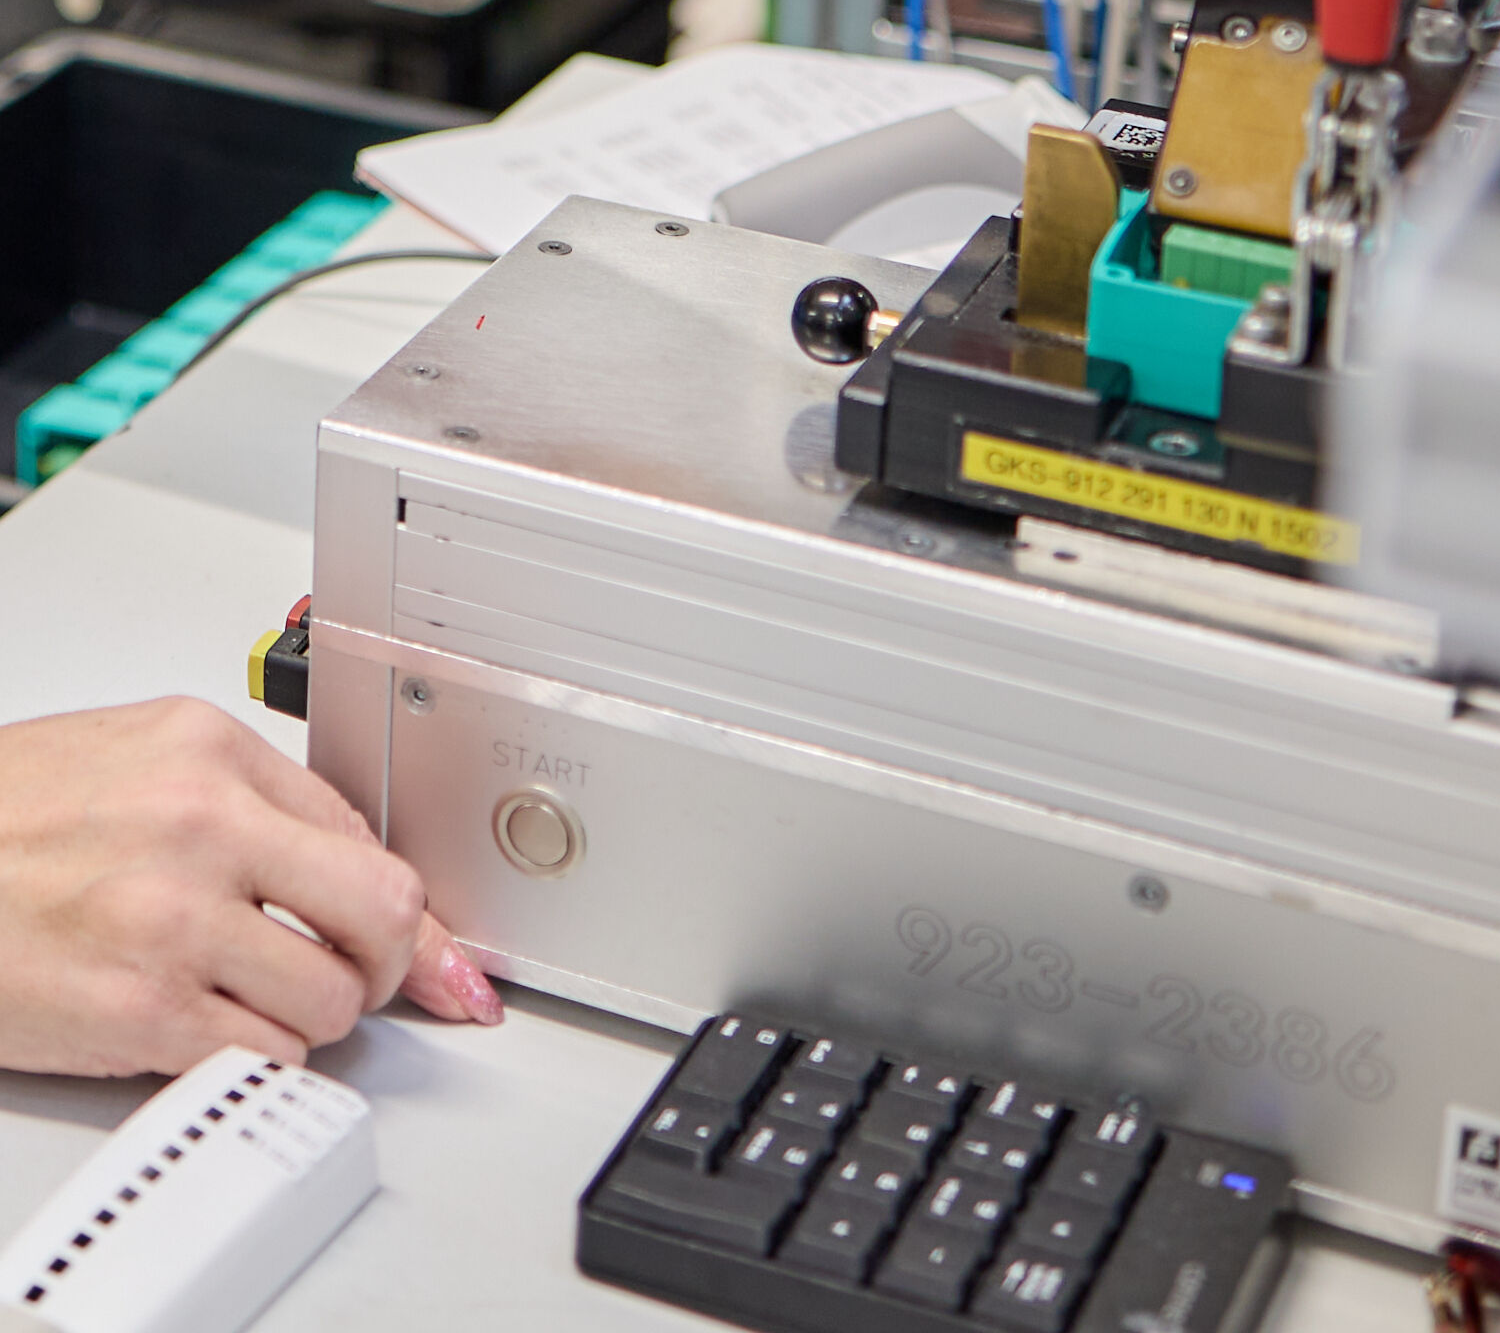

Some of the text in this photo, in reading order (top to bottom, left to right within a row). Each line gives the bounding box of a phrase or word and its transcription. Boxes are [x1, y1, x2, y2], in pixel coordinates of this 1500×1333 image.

[985, 449, 1113, 501] GKS-912
[1122, 484, 1167, 512] 291
[1182, 497, 1229, 531] 130
[1237, 508, 1259, 535] N
[493, 741, 592, 786] START
[896, 905, 1396, 1103] 923-2386
